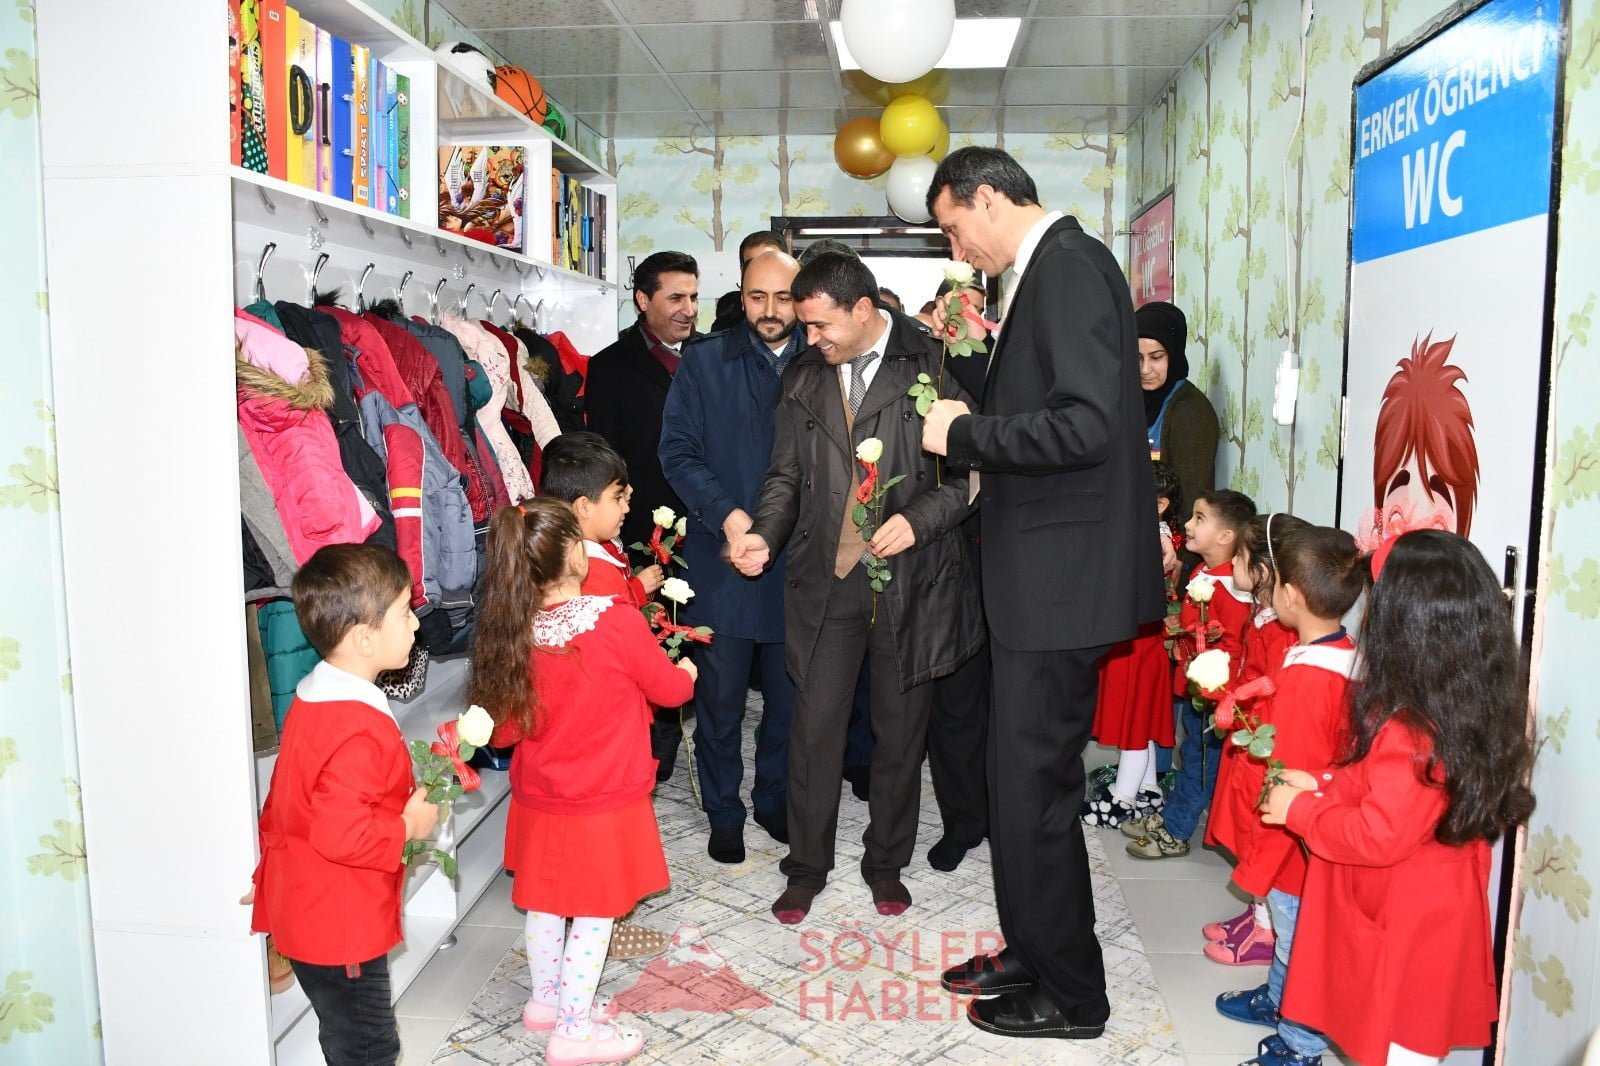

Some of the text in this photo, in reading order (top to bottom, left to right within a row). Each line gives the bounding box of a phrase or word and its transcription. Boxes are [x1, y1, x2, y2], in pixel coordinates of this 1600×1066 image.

[1361, 88, 1420, 159] ERKEK
[1402, 129, 1466, 230] WC
[1142, 256, 1156, 298] WC
